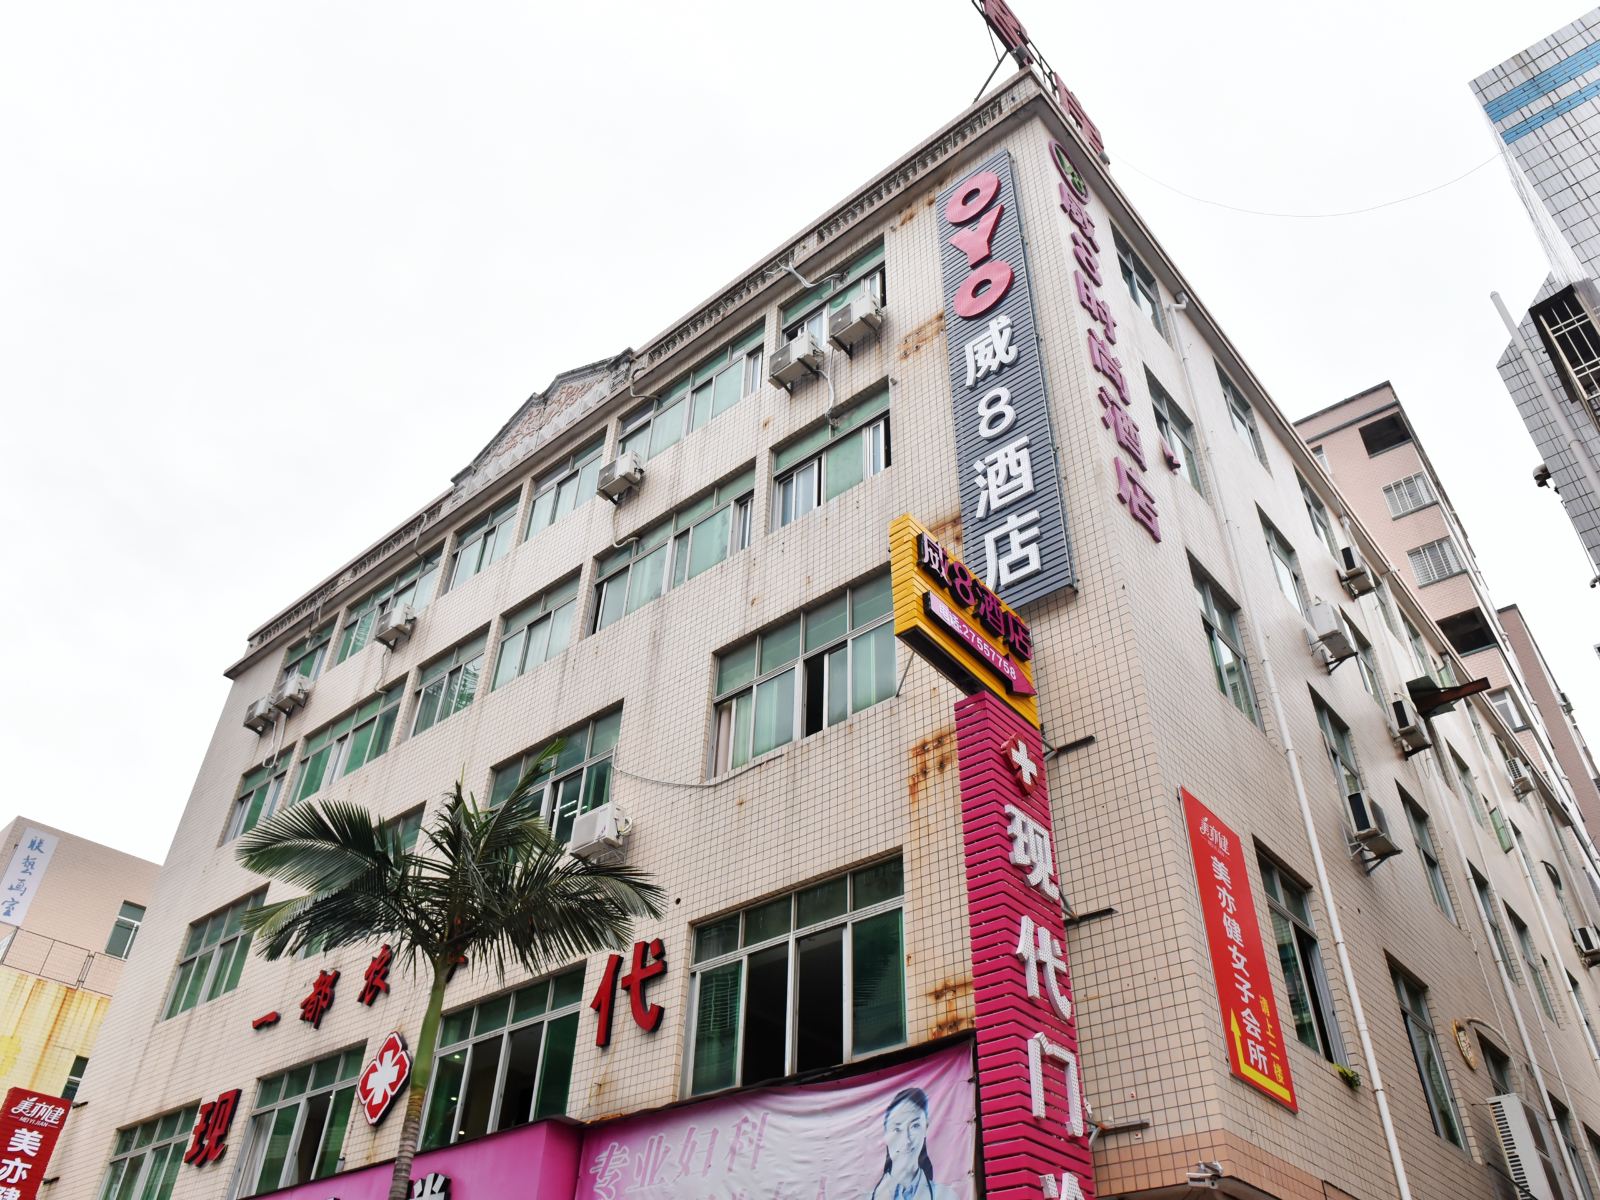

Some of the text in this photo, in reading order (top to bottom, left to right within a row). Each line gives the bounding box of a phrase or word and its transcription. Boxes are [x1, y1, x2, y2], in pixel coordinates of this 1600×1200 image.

[945, 171, 1042, 593] OYO 威8酒店
[920, 532, 1034, 662] 威8酒店
[1004, 803, 1085, 1200] 现代门
[1210, 855, 1269, 1075] 美亦健女子会所
